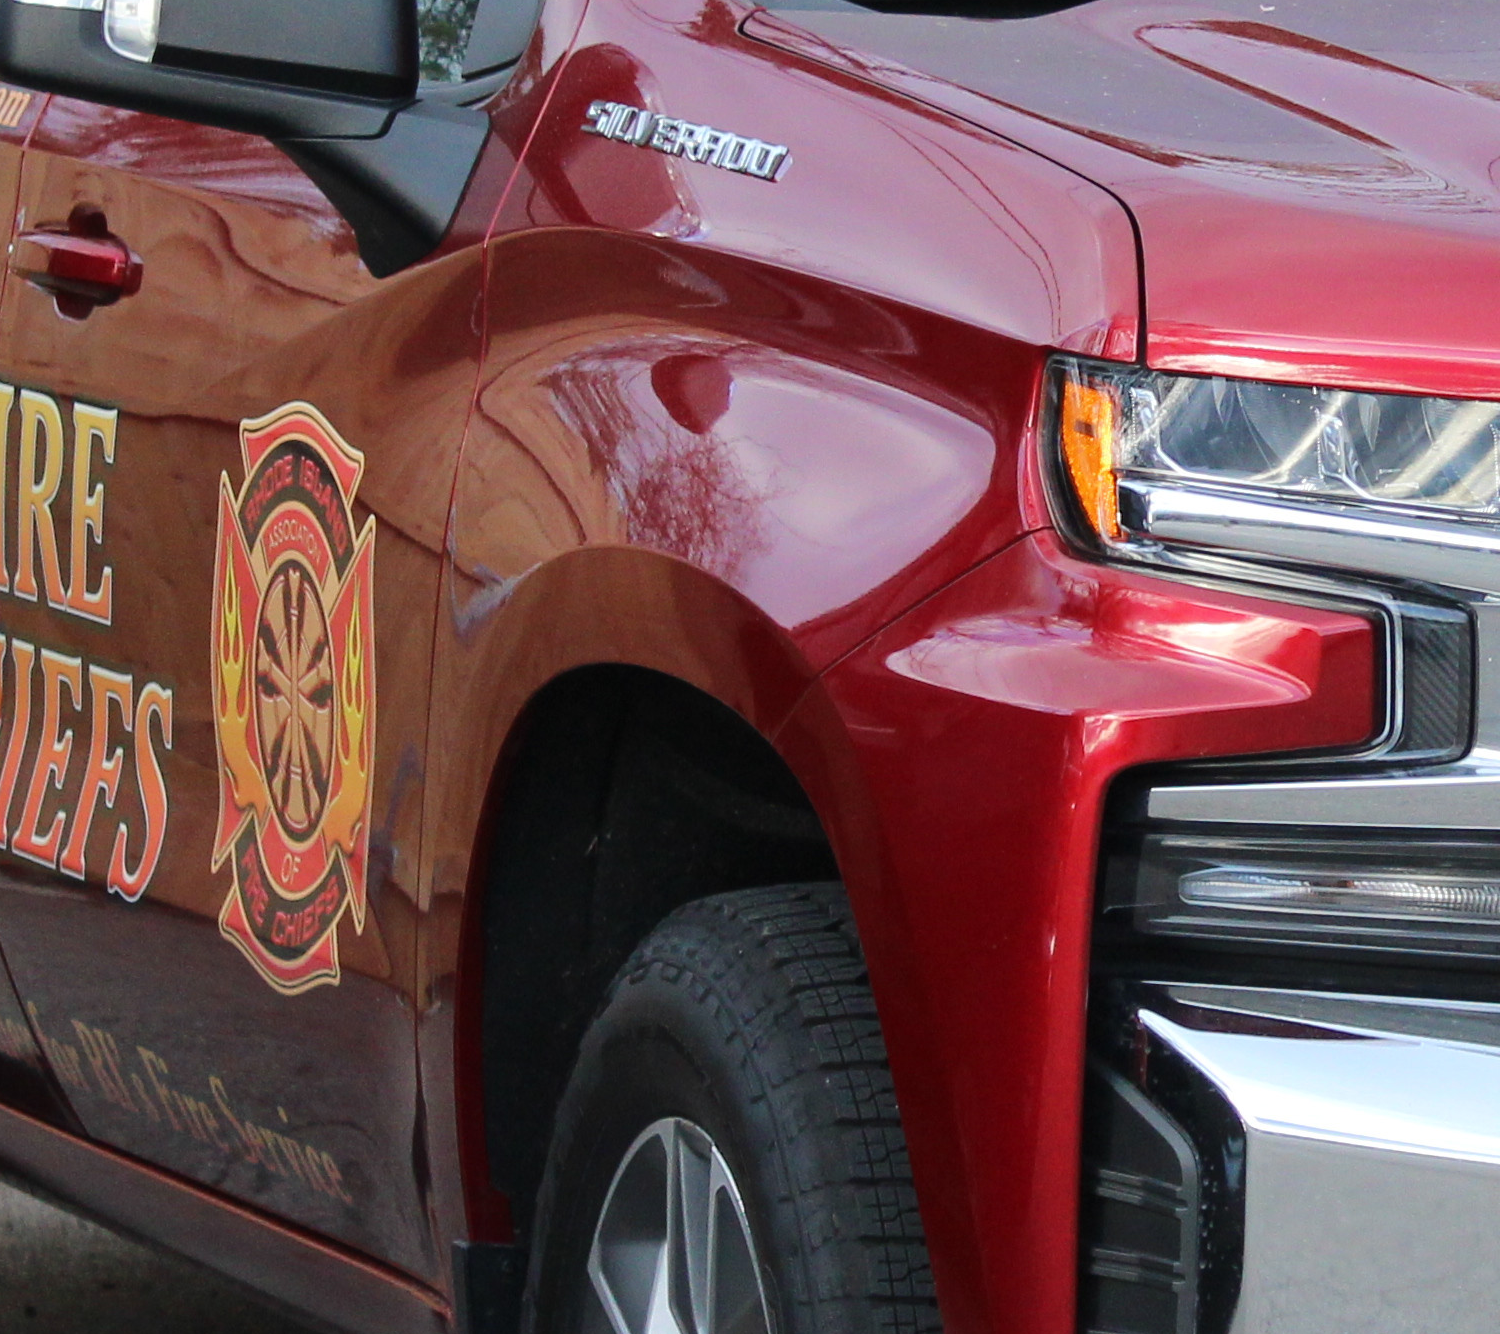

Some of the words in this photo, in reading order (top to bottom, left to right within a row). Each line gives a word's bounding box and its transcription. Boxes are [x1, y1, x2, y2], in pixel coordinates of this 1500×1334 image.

[580, 99, 791, 182] SILVERADO
[243, 453, 295, 534] RHODE
[298, 456, 349, 558] ISLAND
[268, 519, 322, 563] ASSOCIATION
[240, 842, 270, 928] FIRE
[270, 874, 340, 948] CHIEFS
[280, 852, 302, 885] OF
[136, 1045, 230, 1155] Fire
[208, 1074, 354, 1205] Service
